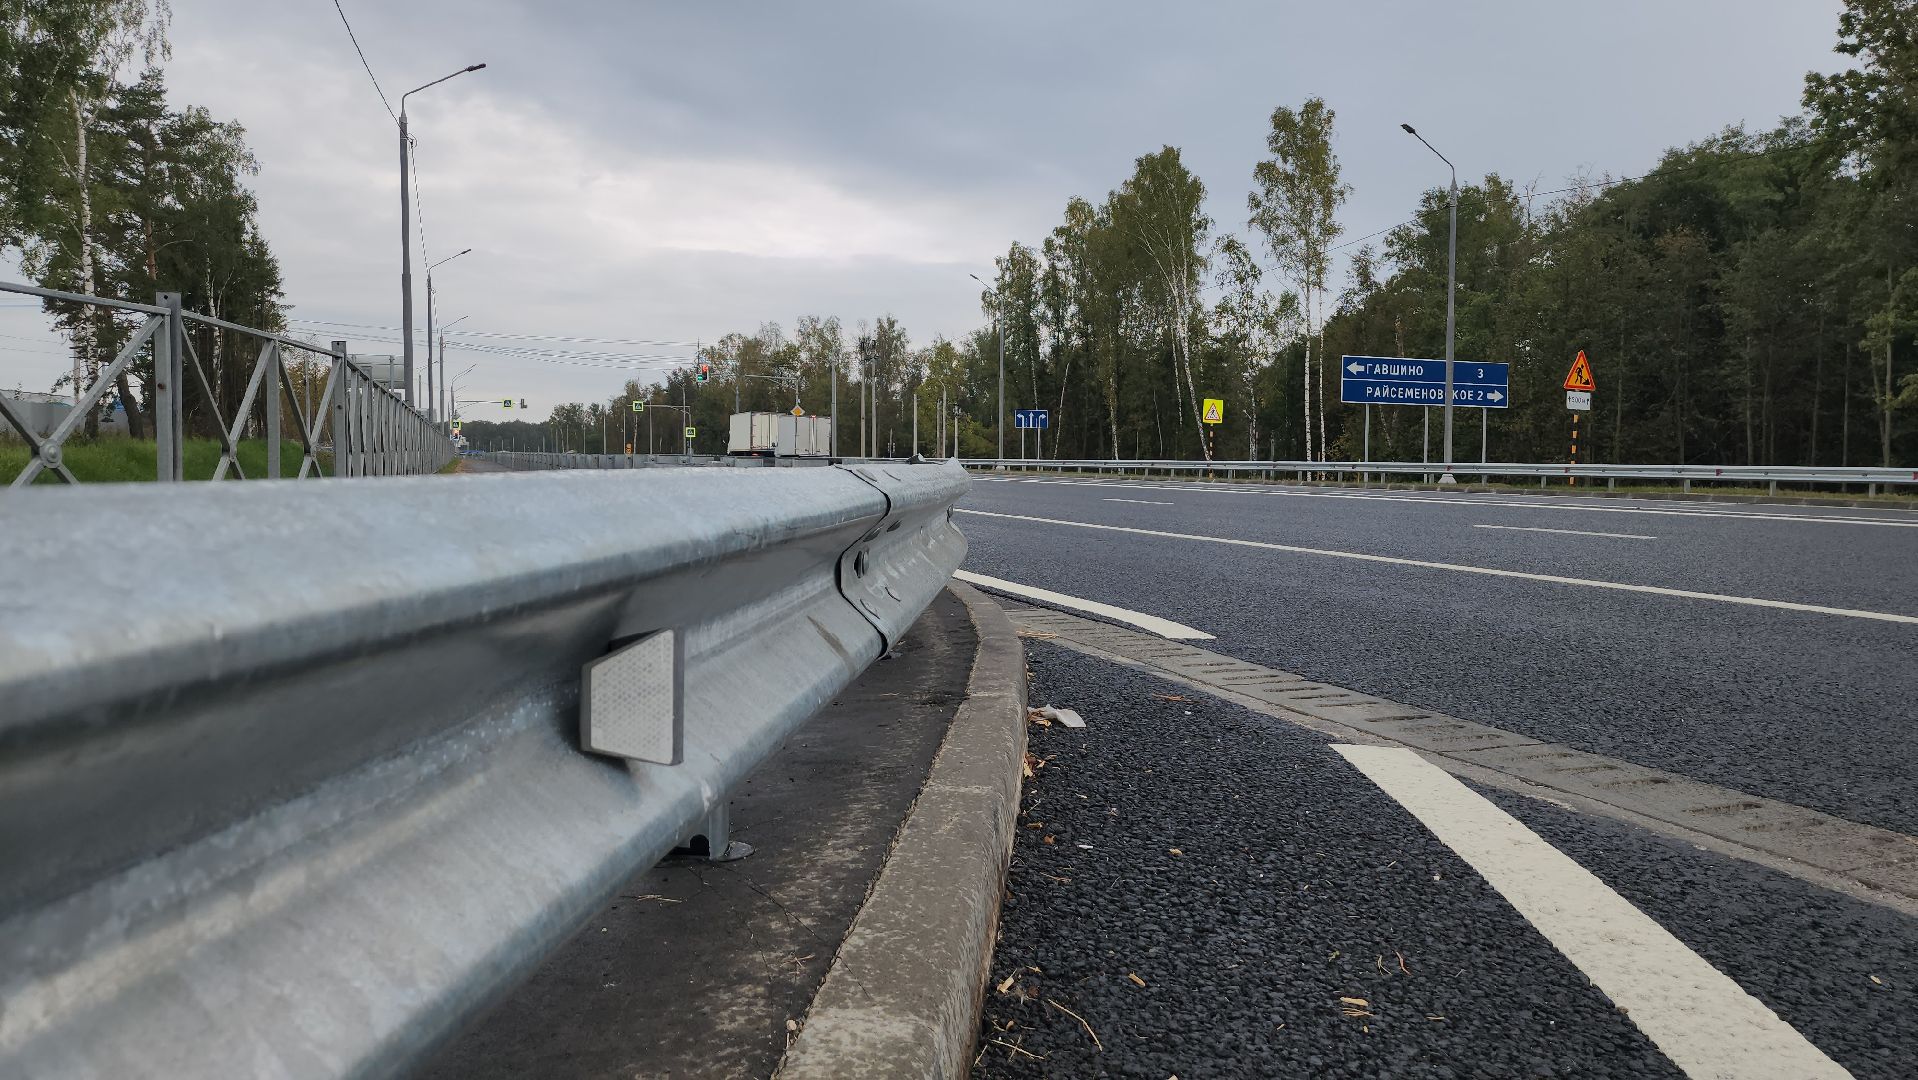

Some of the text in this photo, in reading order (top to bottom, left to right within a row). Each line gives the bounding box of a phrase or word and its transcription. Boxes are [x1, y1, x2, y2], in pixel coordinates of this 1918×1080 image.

[1366, 363, 1484, 379] ГАВШИНО 3
[1366, 385, 1484, 401] РАЙСЕМЕНОВКОЕ 2
